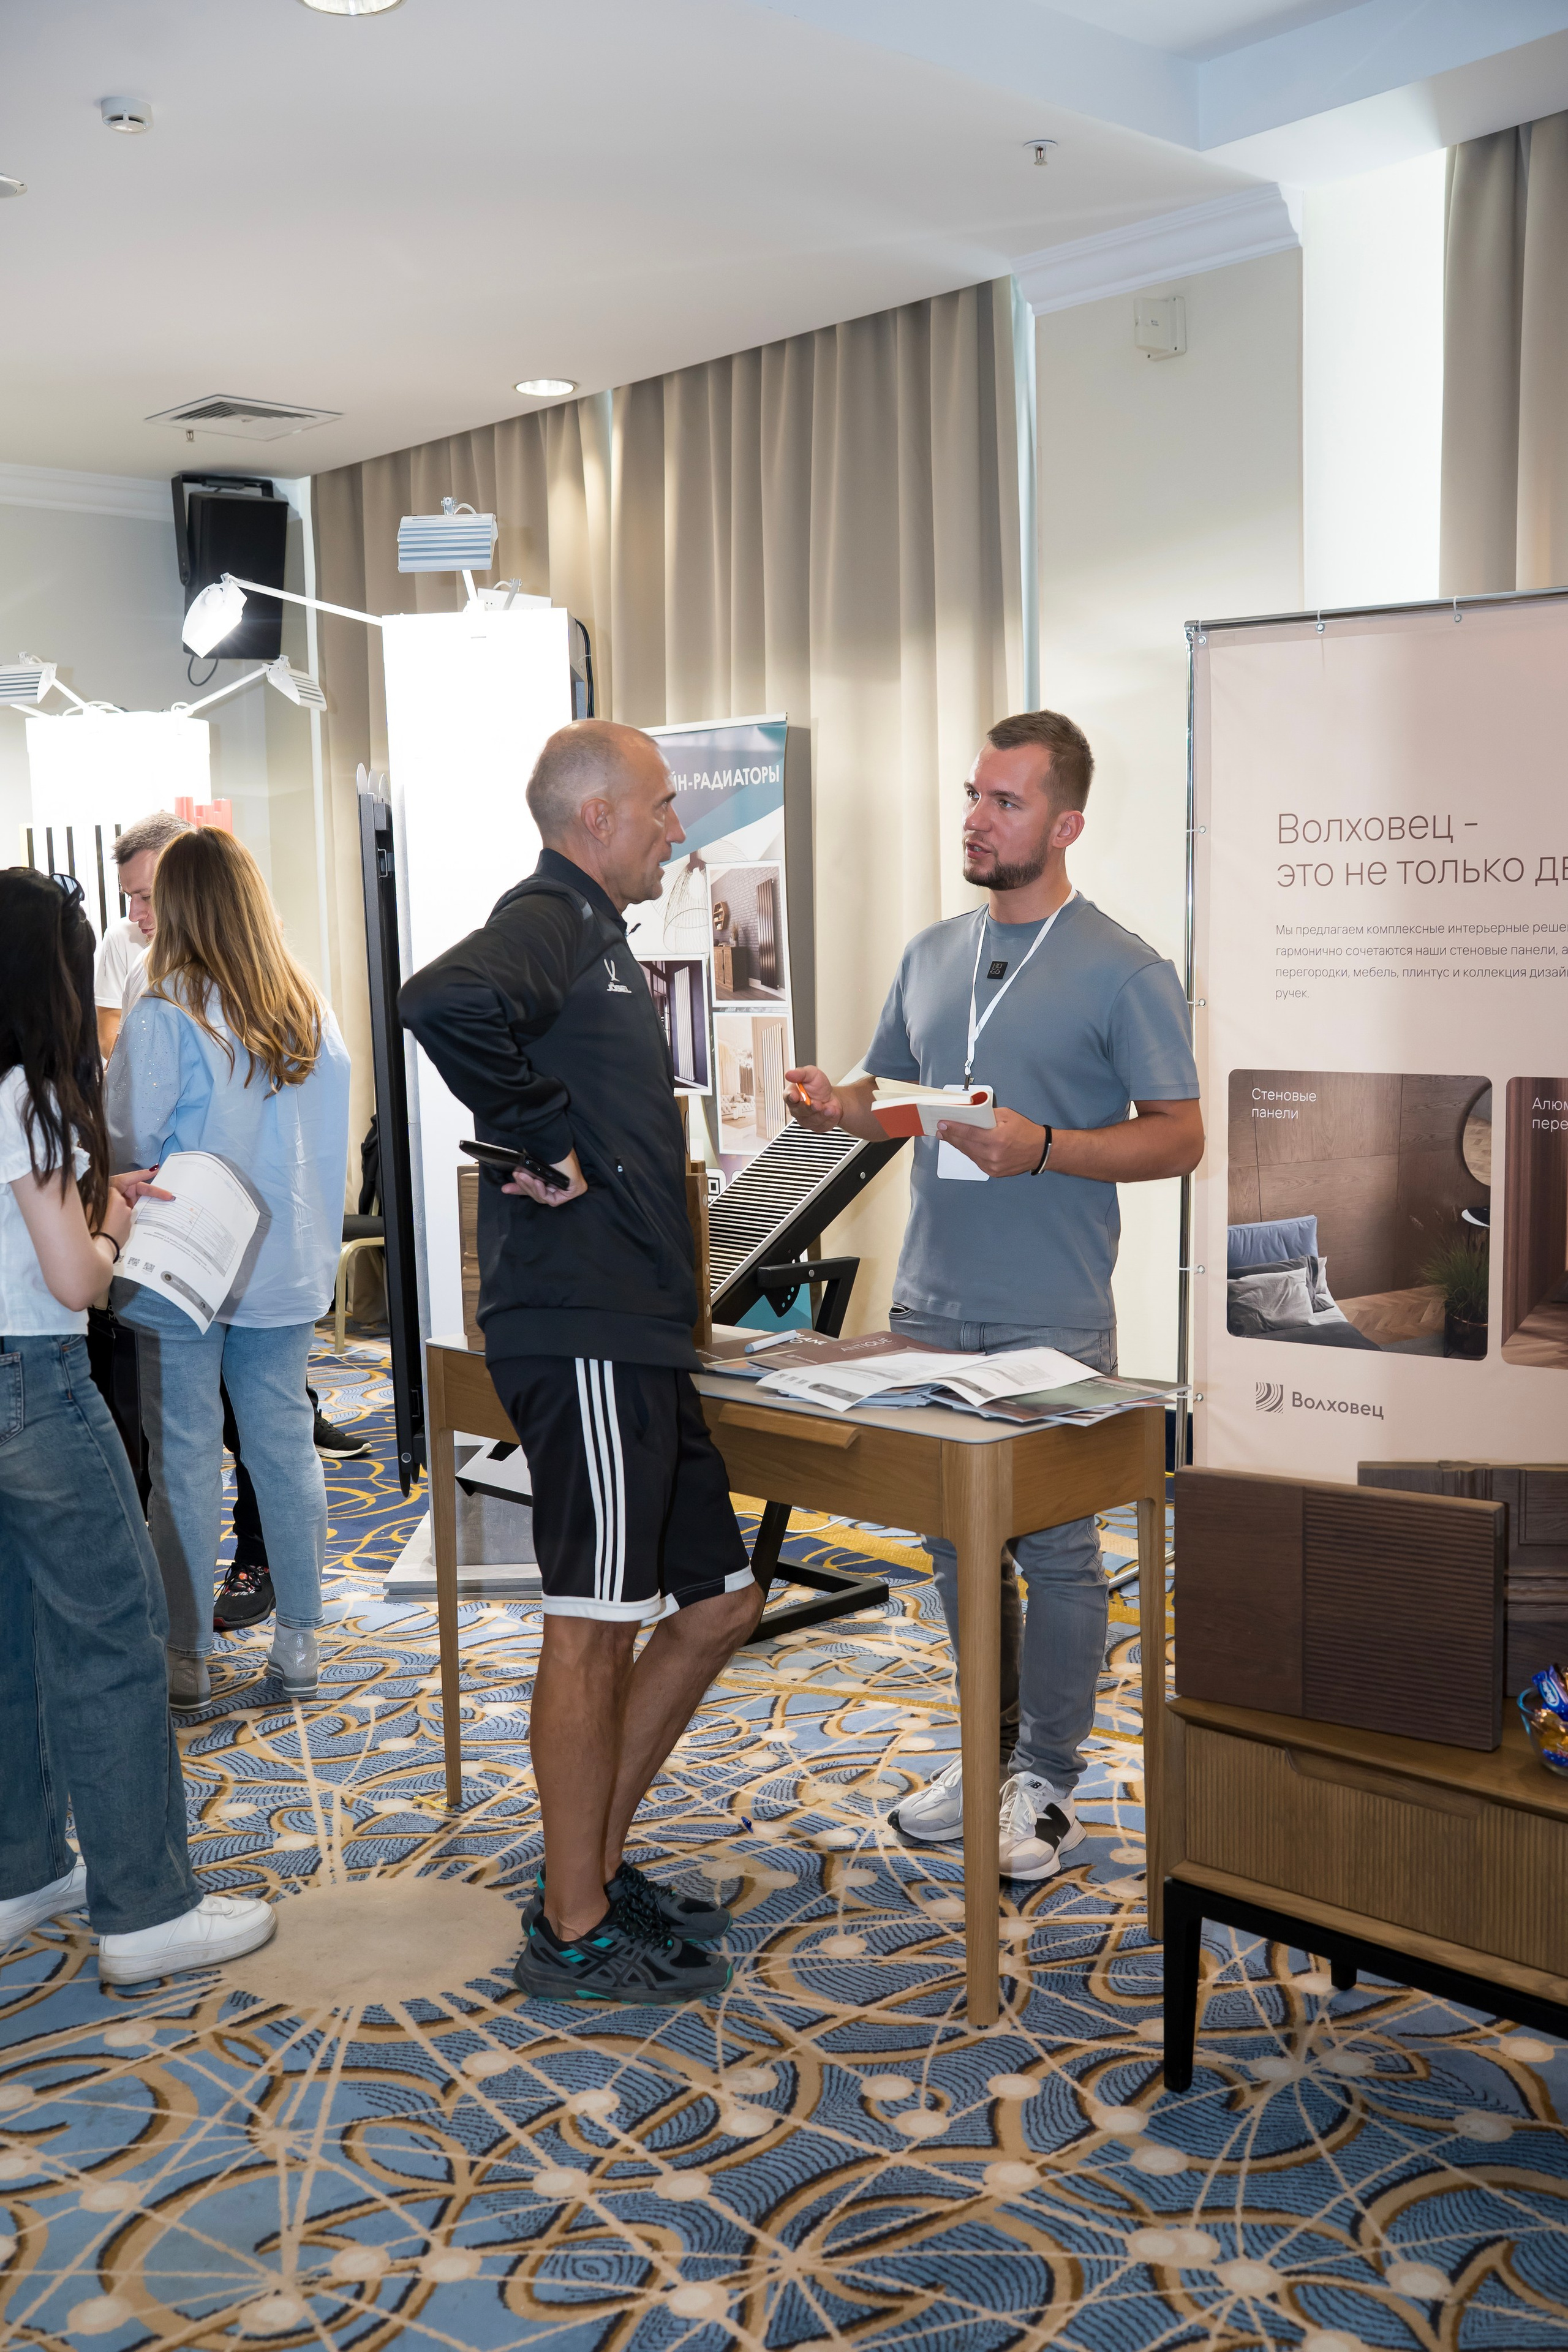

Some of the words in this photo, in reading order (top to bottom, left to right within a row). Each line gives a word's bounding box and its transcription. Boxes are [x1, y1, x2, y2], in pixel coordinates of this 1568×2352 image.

[1278, 813, 1454, 844] Волховец
[1277, 862, 1334, 888] это
[1346, 861, 1387, 886] не
[1396, 857, 1525, 885] только
[1276, 925, 1293, 935] Мы
[1295, 925, 1364, 937] предлагаем
[1366, 925, 1445, 935] комплексные
[1448, 924, 1529, 935] интерьерные
[1532, 923, 1568, 935] реше
[1276, 947, 1343, 957] гармонично
[1346, 947, 1412, 956] сочетаются
[1415, 947, 1447, 956] наши
[1450, 946, 1508, 956] стеновые
[1510, 946, 1558, 956] панели,
[1276, 968, 1351, 980] перегородки,
[1353, 967, 1400, 979] мебель,
[1402, 968, 1450, 979] плинтус
[1452, 968, 1460, 978] и
[1463, 968, 1527, 979] коллекция
[1529, 966, 1568, 979] дизай
[1276, 989, 1310, 1000] ручек.
[1251, 1087, 1317, 1102] Стеновые
[1251, 1108, 1298, 1120] панели
[841, 1337, 892, 1352] ANTIQUE
[1292, 1391, 1384, 1420] Волховец
